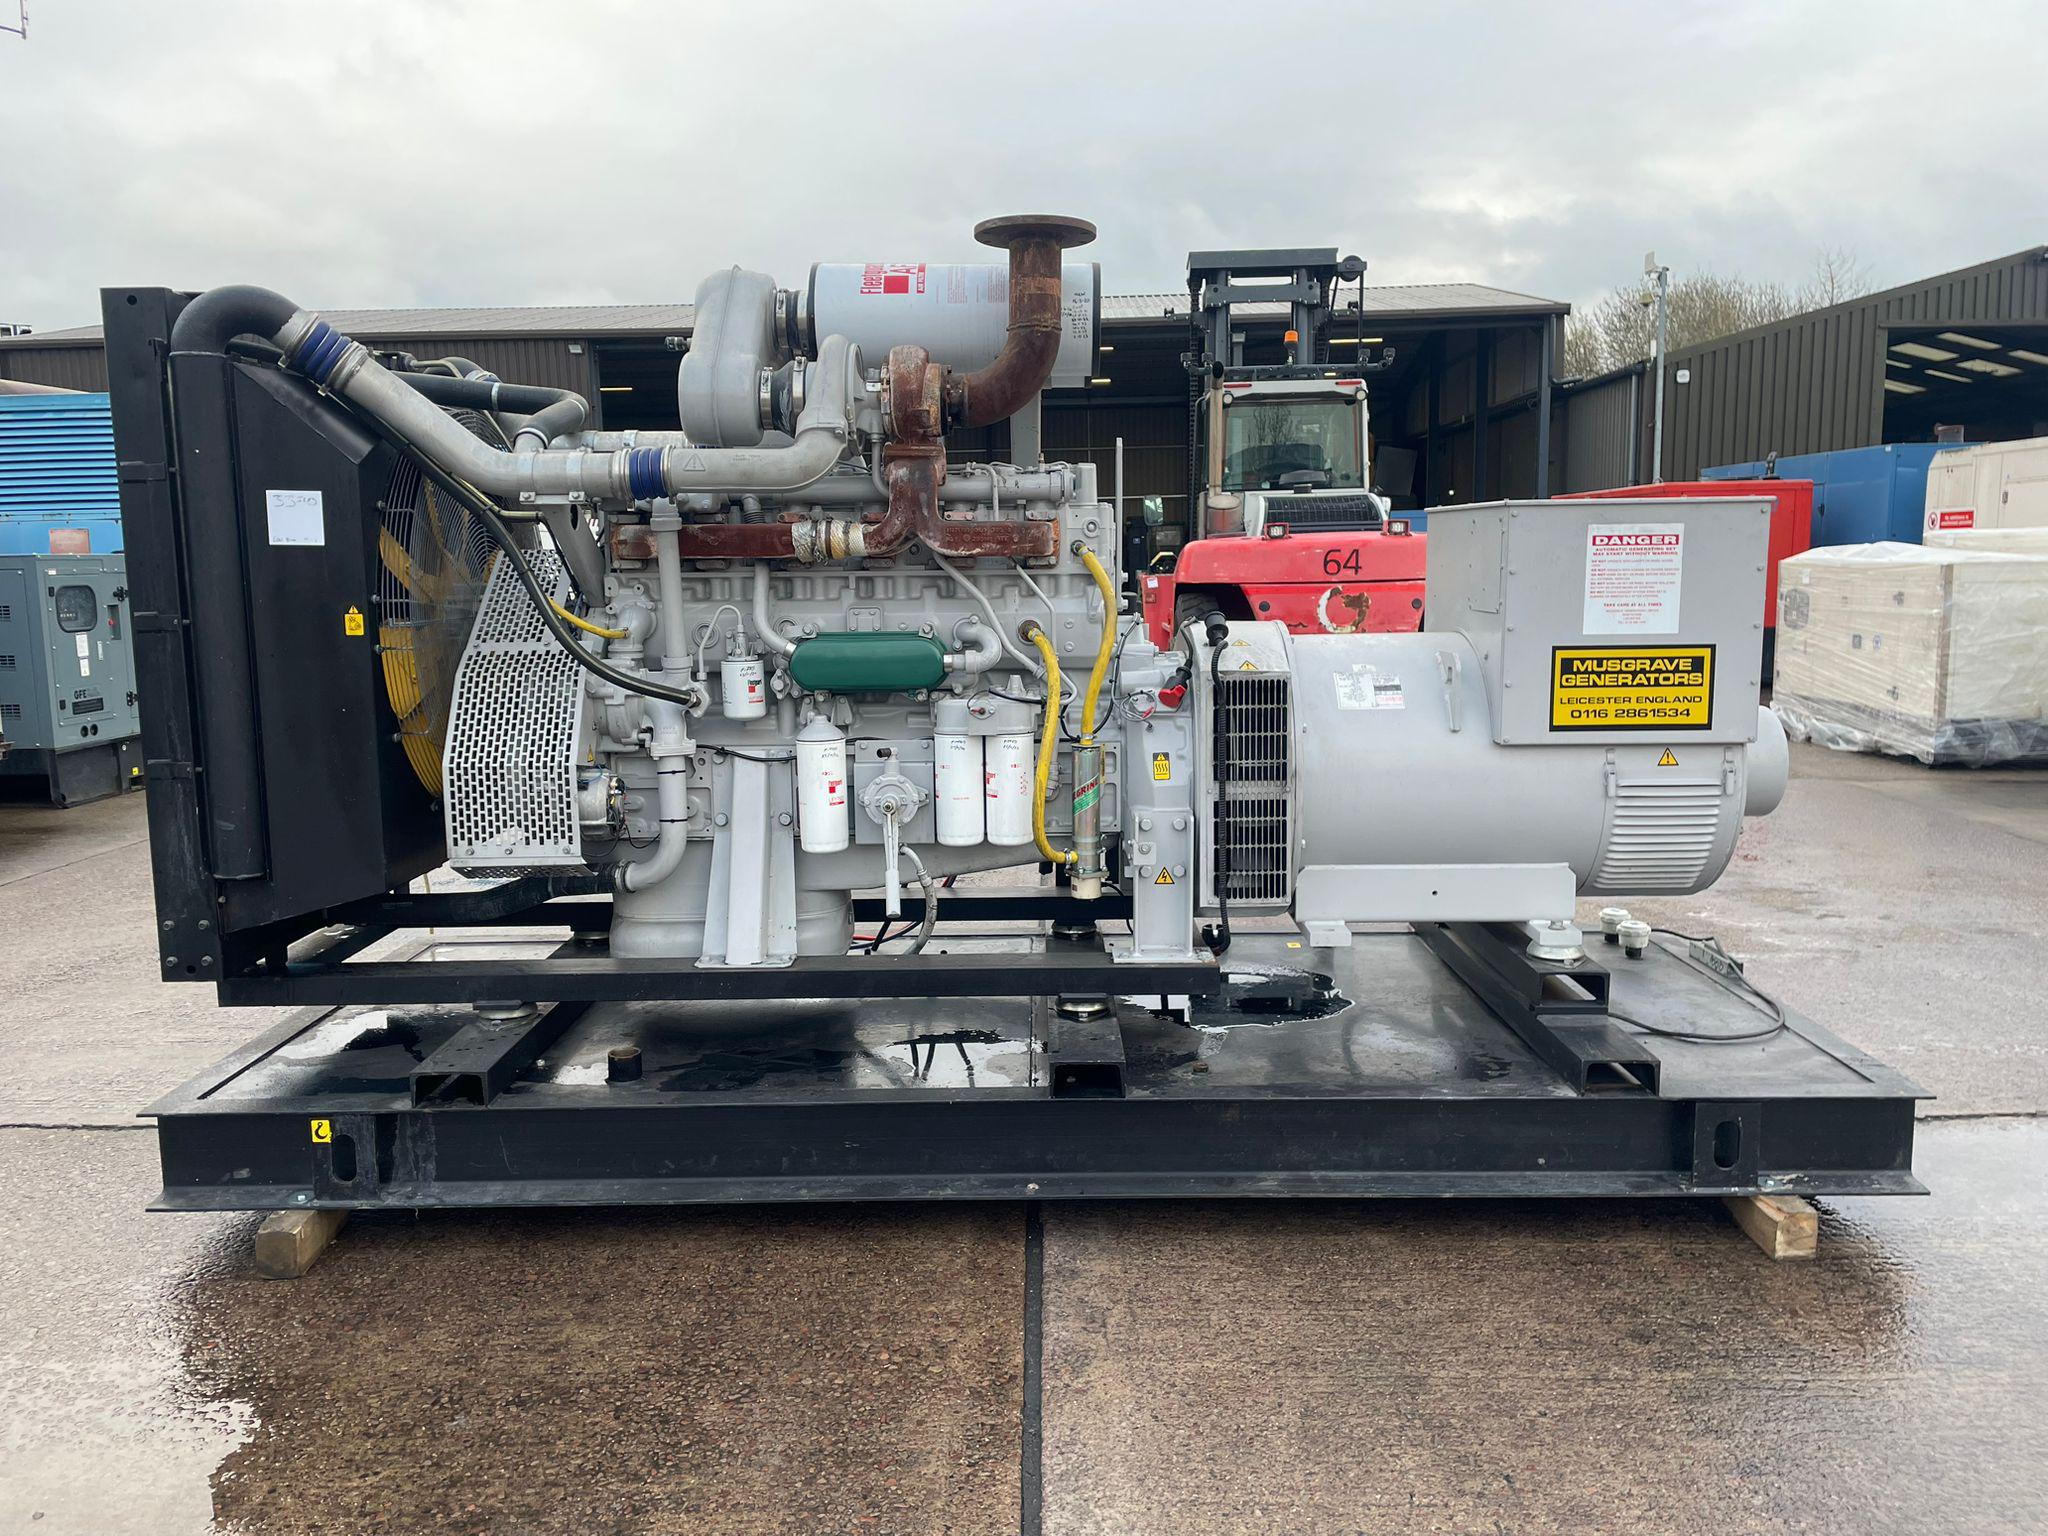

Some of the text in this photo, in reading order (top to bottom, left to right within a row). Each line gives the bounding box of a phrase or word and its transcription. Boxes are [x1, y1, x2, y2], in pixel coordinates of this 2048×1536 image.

[1594, 535, 1678, 545] DANGER
[1323, 549, 1362, 575] 64
[1573, 659, 1692, 671] MUSGRAVE
[1561, 672, 1703, 687] GENERATORS
[1560, 695, 1703, 705] LEICESTER ENGLAND
[1570, 708, 1691, 719] 0116 2861534
